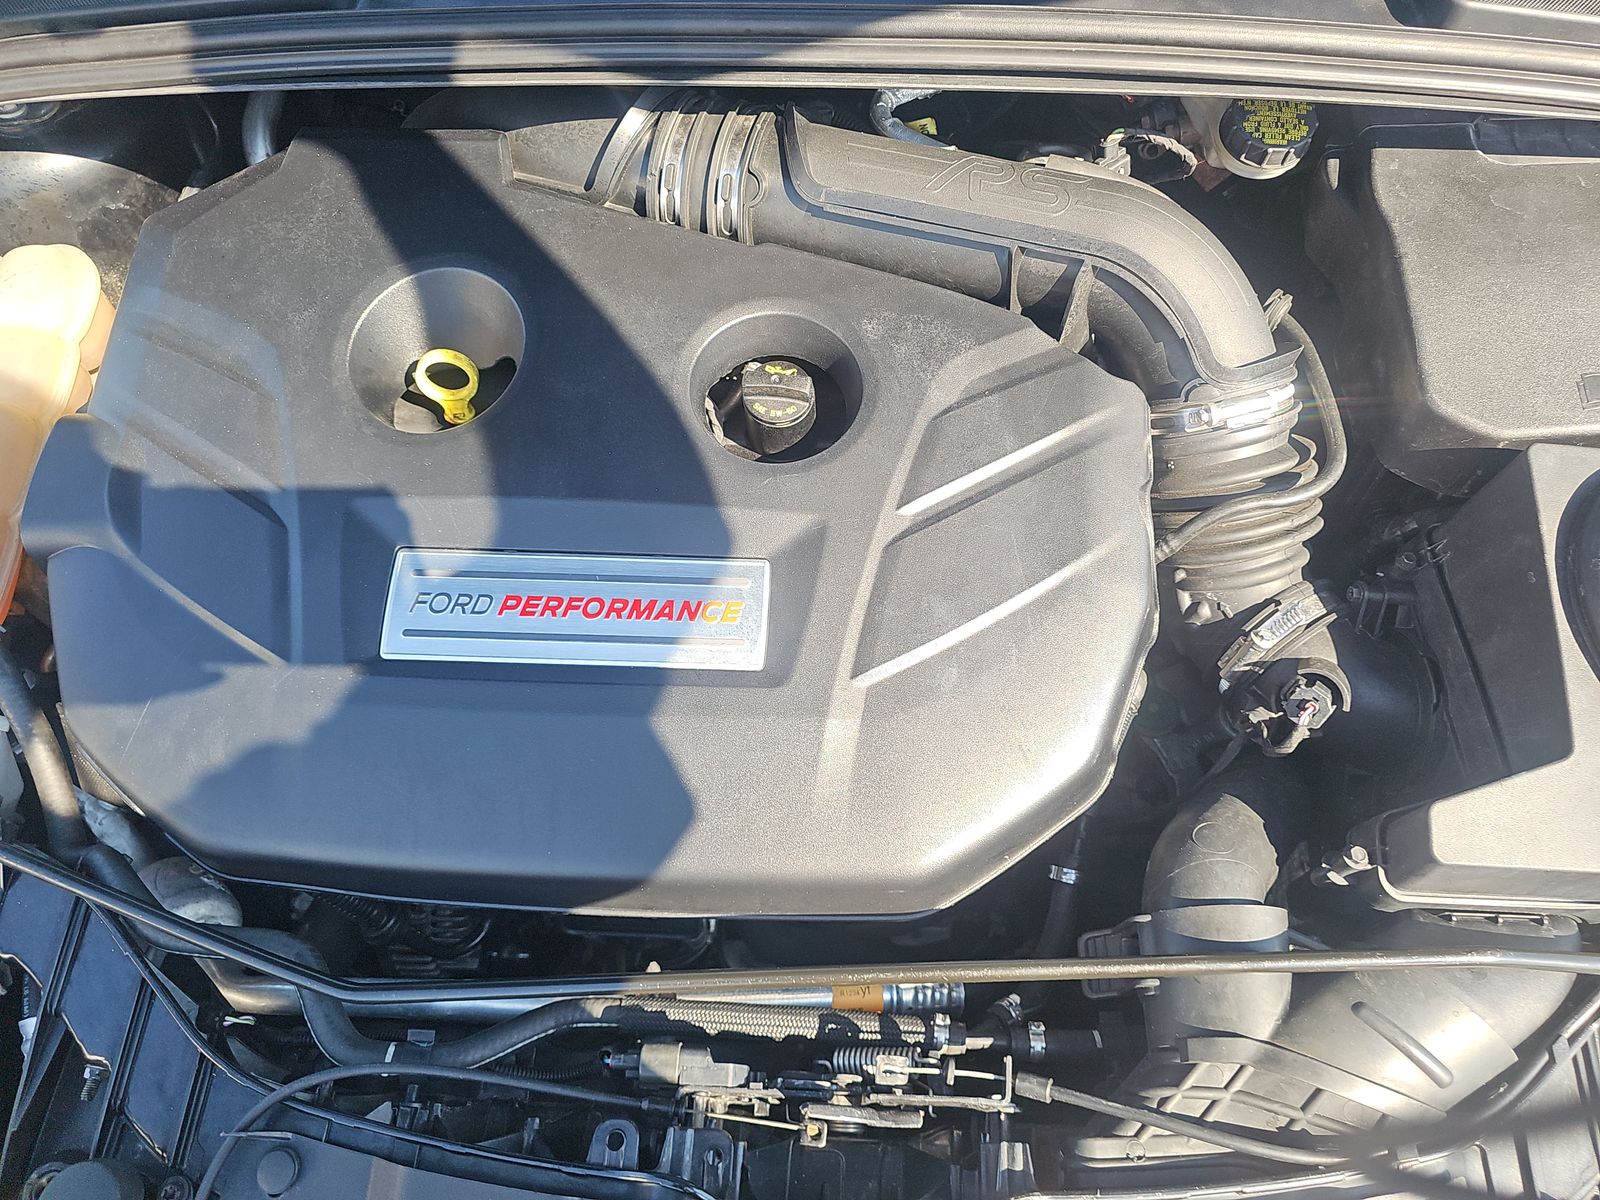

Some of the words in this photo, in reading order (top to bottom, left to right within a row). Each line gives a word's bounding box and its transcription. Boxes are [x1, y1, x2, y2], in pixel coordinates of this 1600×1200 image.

[921, 155, 1091, 217] RS
[753, 402, 768, 415] SAE
[408, 591, 494, 617] FORD
[496, 594, 746, 624] PERFORMANCE
